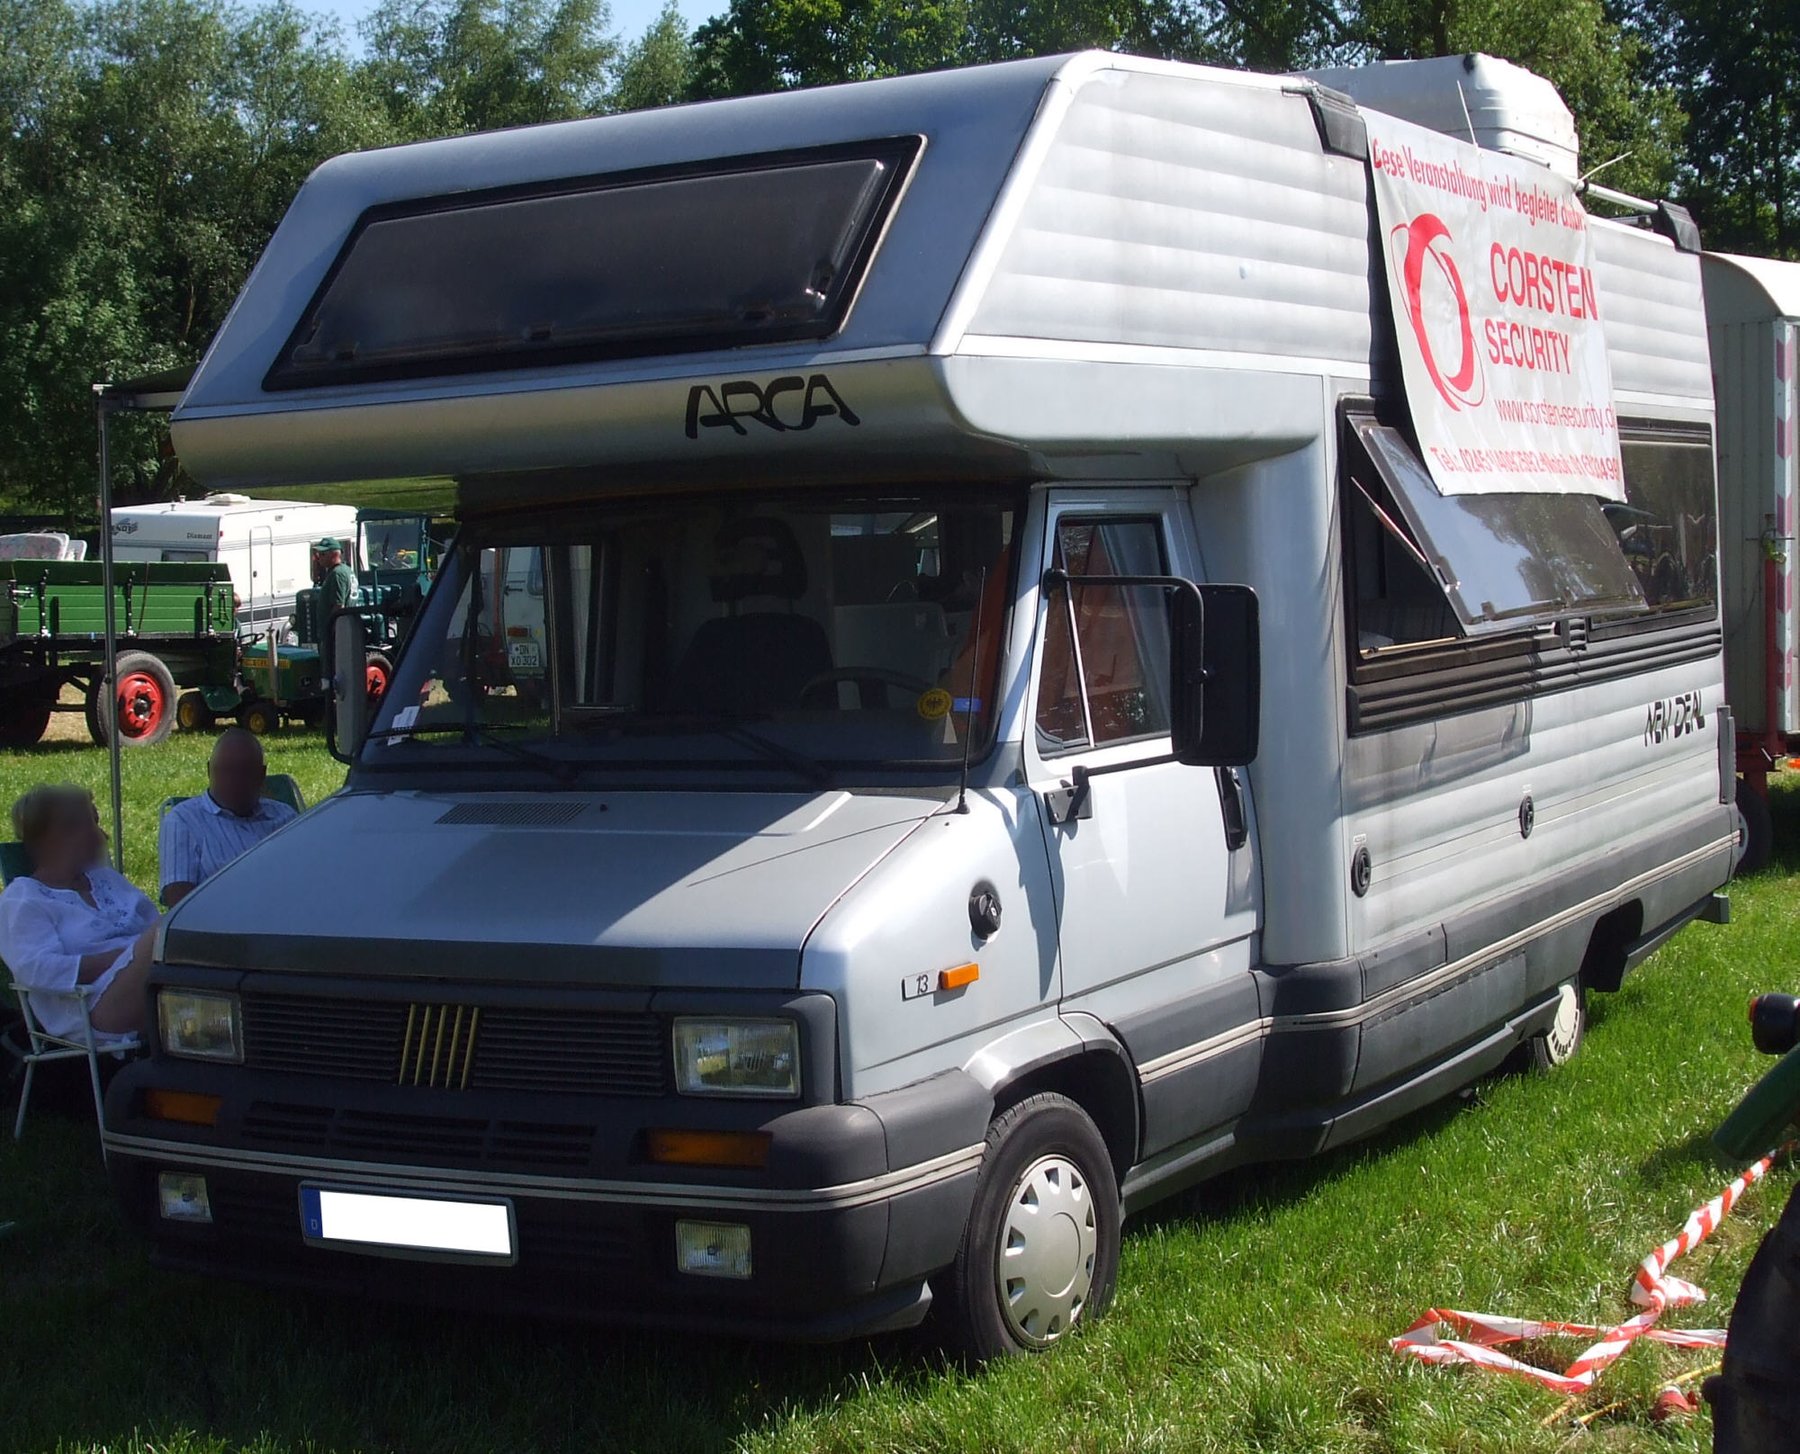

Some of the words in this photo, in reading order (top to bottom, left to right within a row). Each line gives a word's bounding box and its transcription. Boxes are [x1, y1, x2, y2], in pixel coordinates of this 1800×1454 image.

[1402, 144, 1486, 212] Veranstaltung
[1487, 175, 1512, 209] wird
[1515, 179, 1558, 226] begleitet
[1490, 242, 1598, 320] CORSTEN
[1485, 318, 1570, 375] SECURITY
[685, 374, 860, 439] ARCA
[1494, 398, 1617, 435] www.corsten-security.d
[1645, 700, 1672, 747] NEW
[1674, 690, 1705, 738] DEAL
[916, 974, 929, 994] 13
